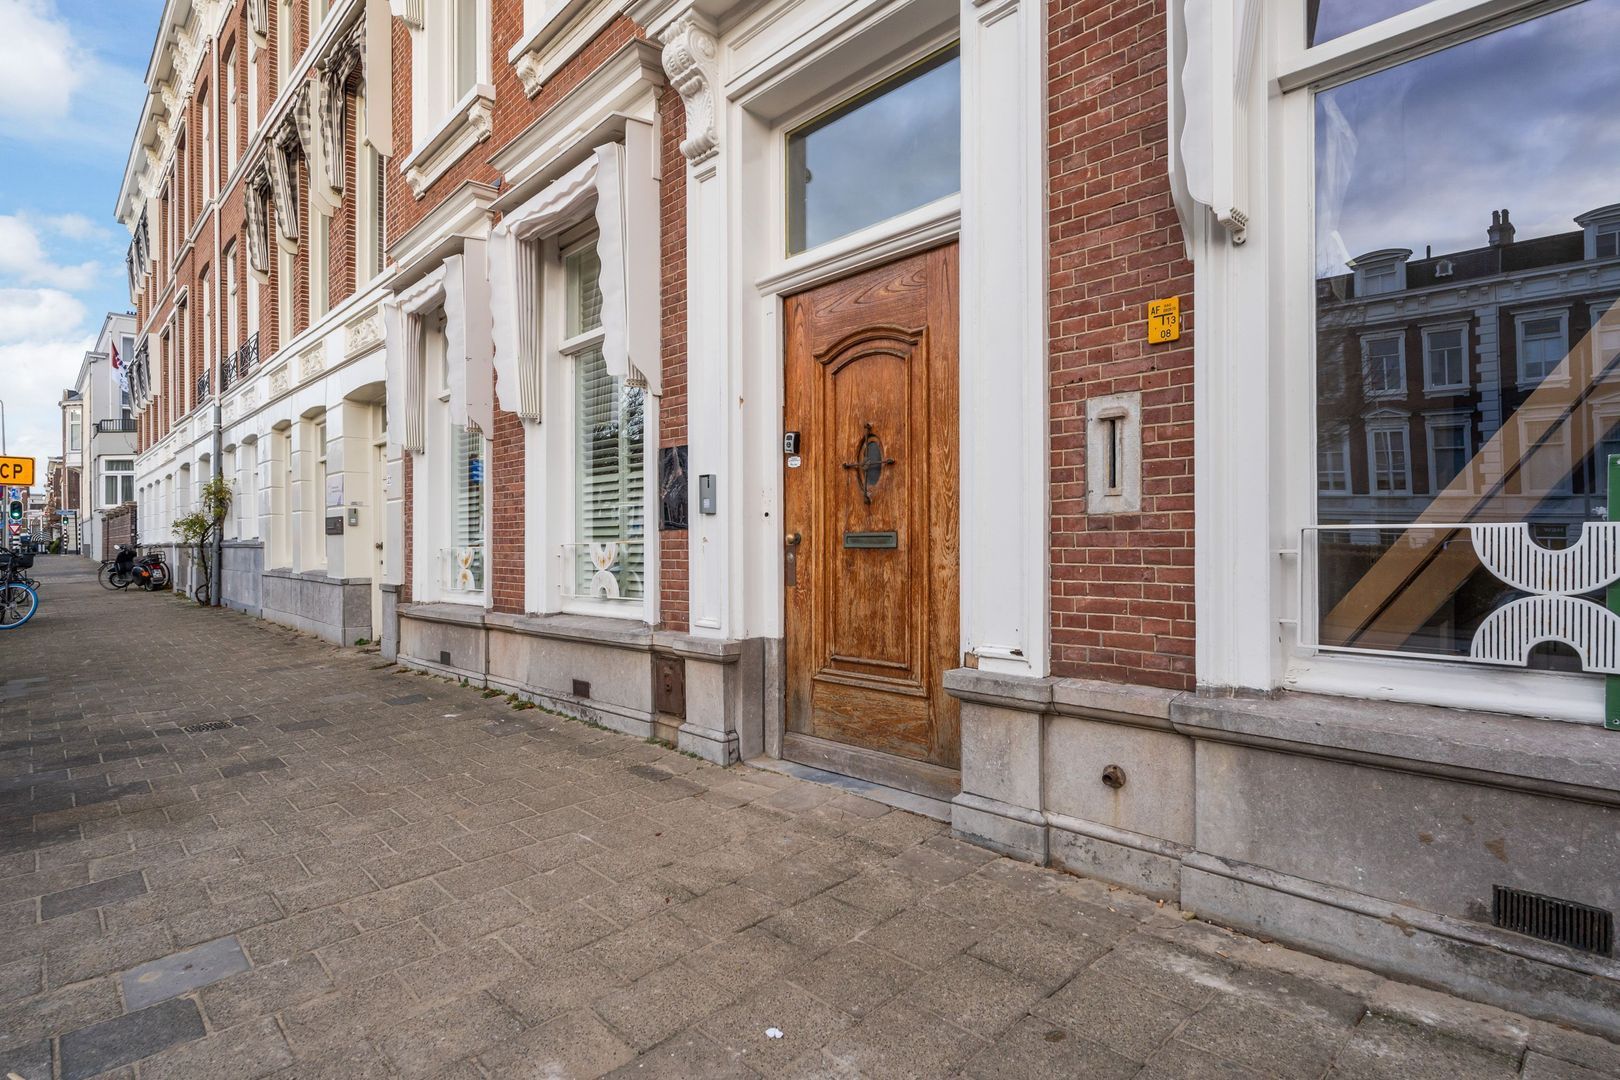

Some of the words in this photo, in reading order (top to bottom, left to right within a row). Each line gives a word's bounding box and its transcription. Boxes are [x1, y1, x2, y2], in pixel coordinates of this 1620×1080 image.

[1151, 305, 1160, 315] AF
[1166, 315, 1176, 325] 13
[1161, 329, 1171, 338] 08
[0, 463, 23, 479] CP
